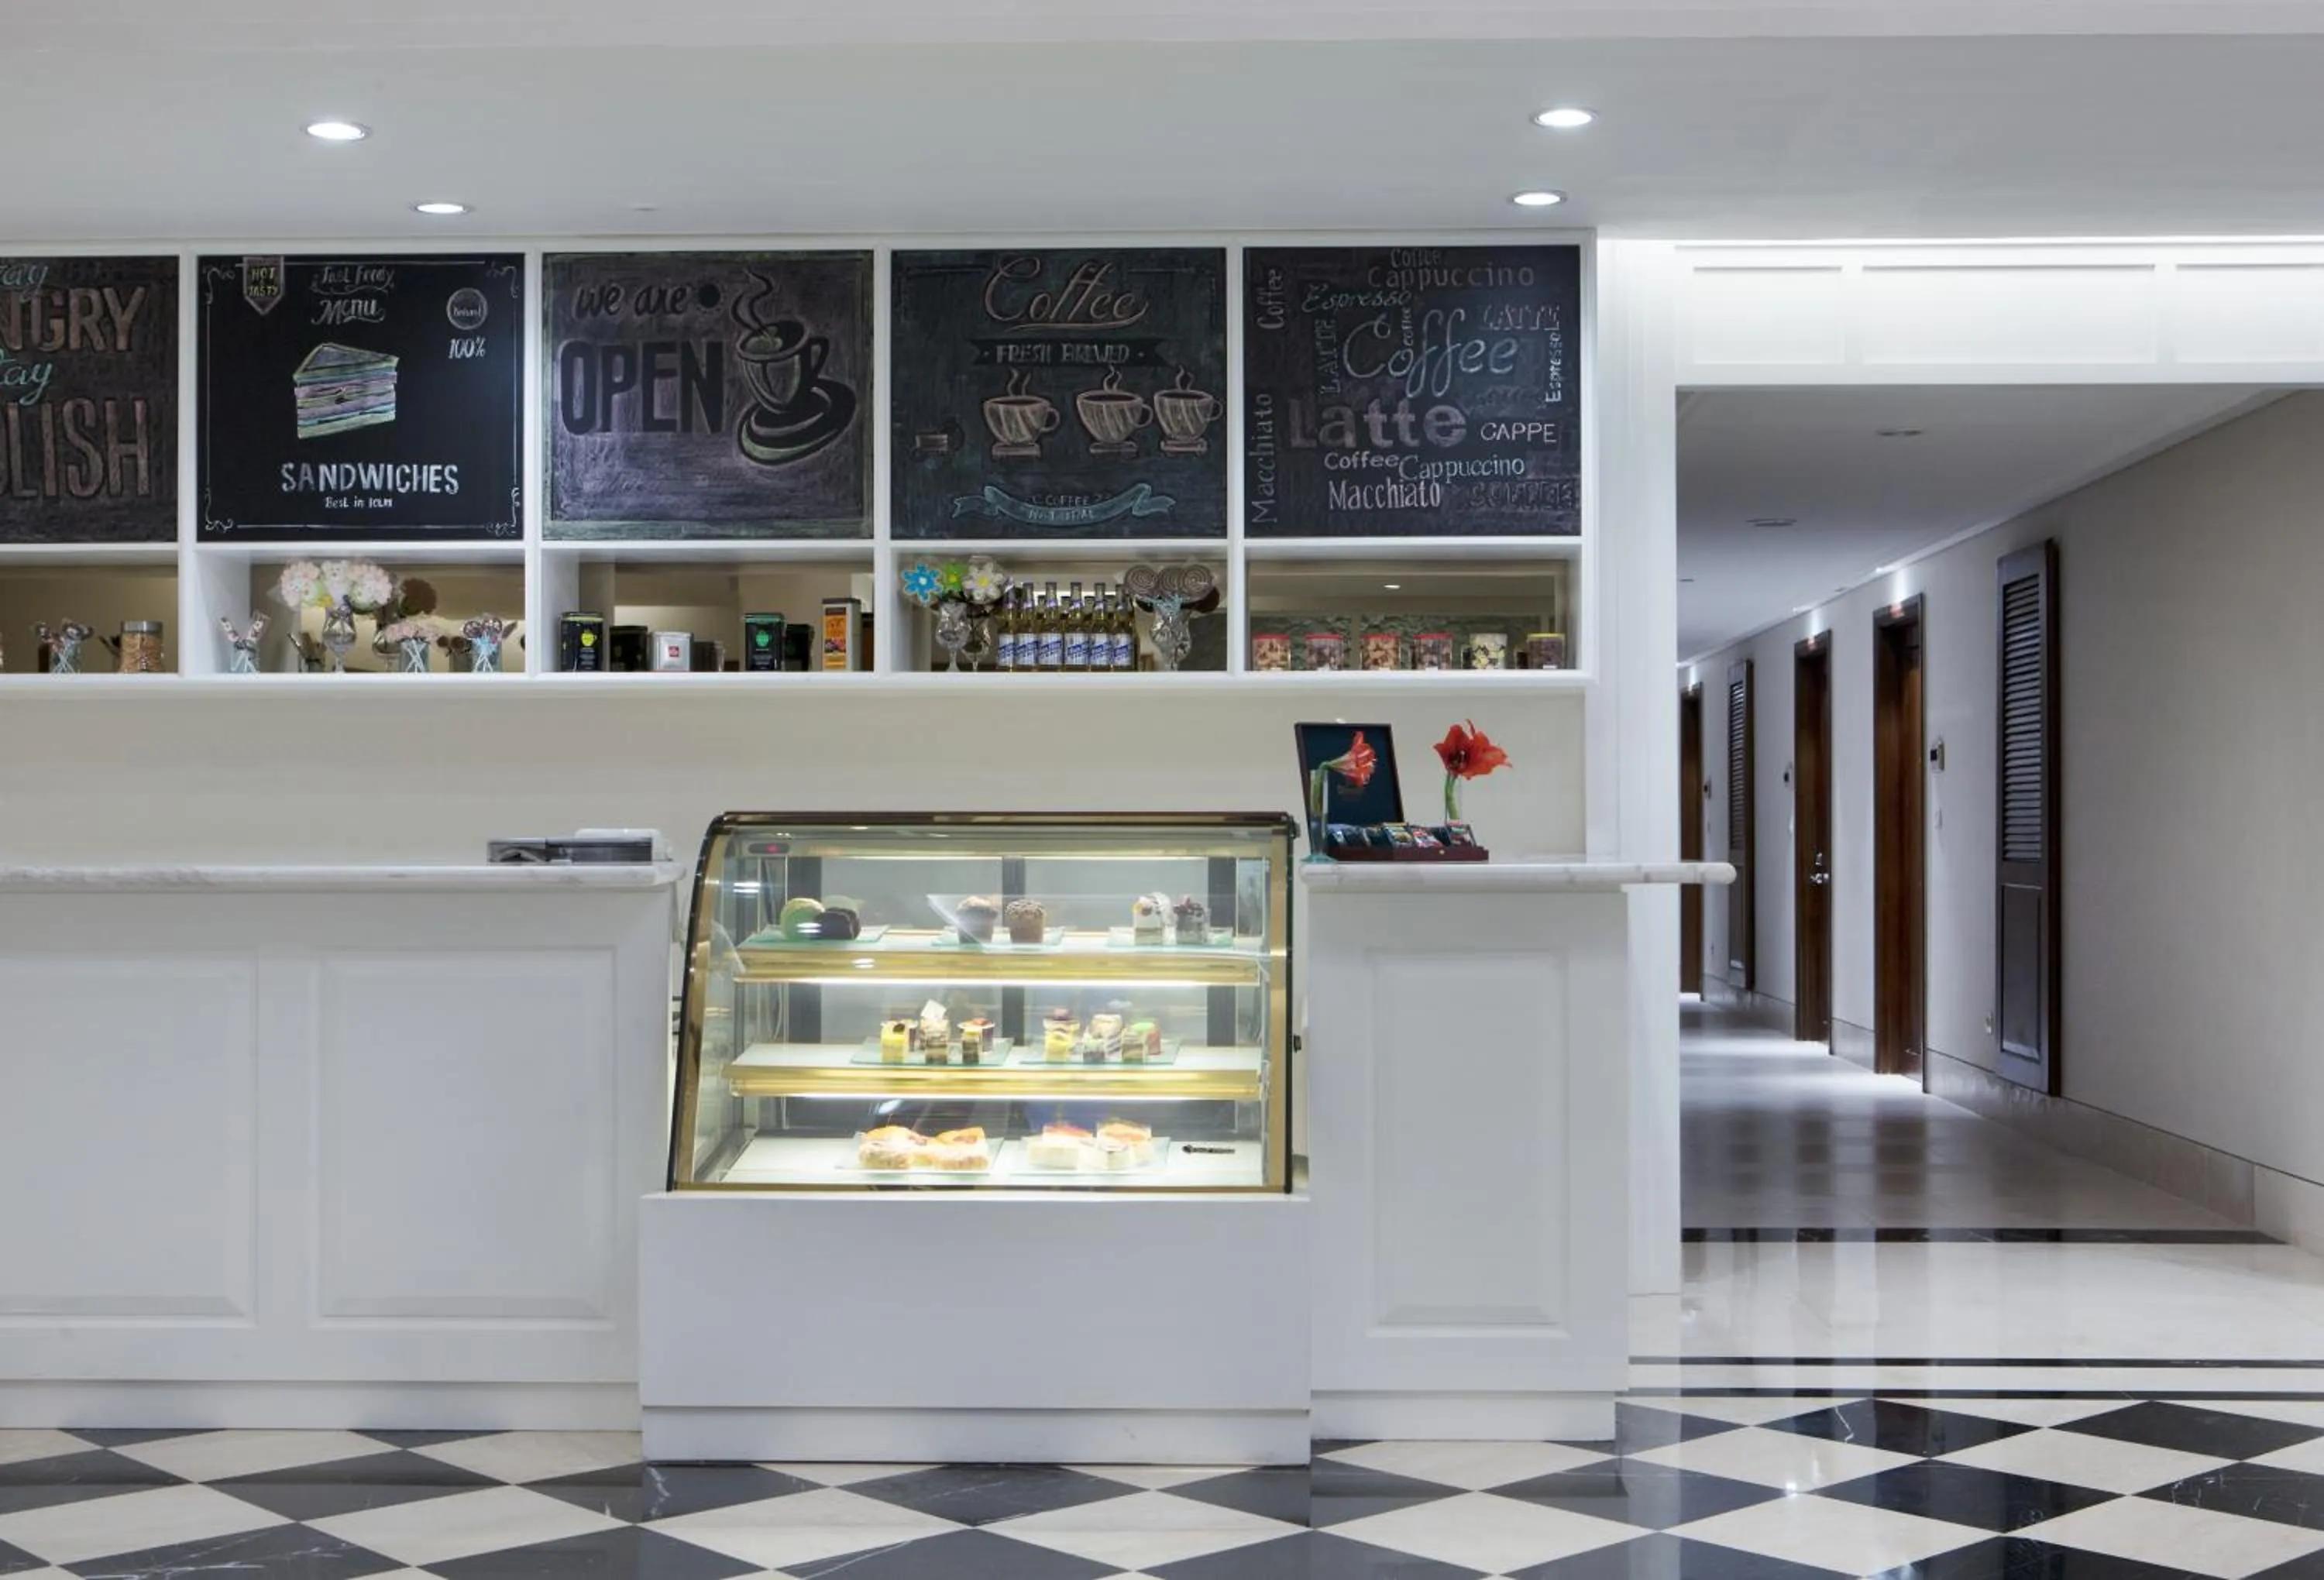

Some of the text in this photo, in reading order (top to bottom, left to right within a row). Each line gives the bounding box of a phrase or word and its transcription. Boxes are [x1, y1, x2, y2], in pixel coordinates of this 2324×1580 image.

[0, 264, 50, 304] ay
[985, 256, 1149, 325] Coffee
[1367, 262, 1535, 291] Cappuccino
[576, 283, 692, 319] we are
[1301, 282, 1412, 315] Espresso
[447, 335, 488, 360] 100%
[995, 343, 1052, 365] FRESH
[1342, 308, 1519, 398] Coffee
[559, 338, 725, 436] OPEN
[1287, 397, 1468, 448] Latte
[1480, 422, 1557, 443] CAPPE
[0, 397, 151, 497] LISH
[1248, 393, 1278, 524] Macchiato
[280, 462, 460, 495] SANDWICHES
[1323, 450, 1526, 484] Coffee Cappuccino
[325, 496, 350, 509] Best
[353, 495, 366, 509] in
[1327, 475, 1442, 512] Macchiato
